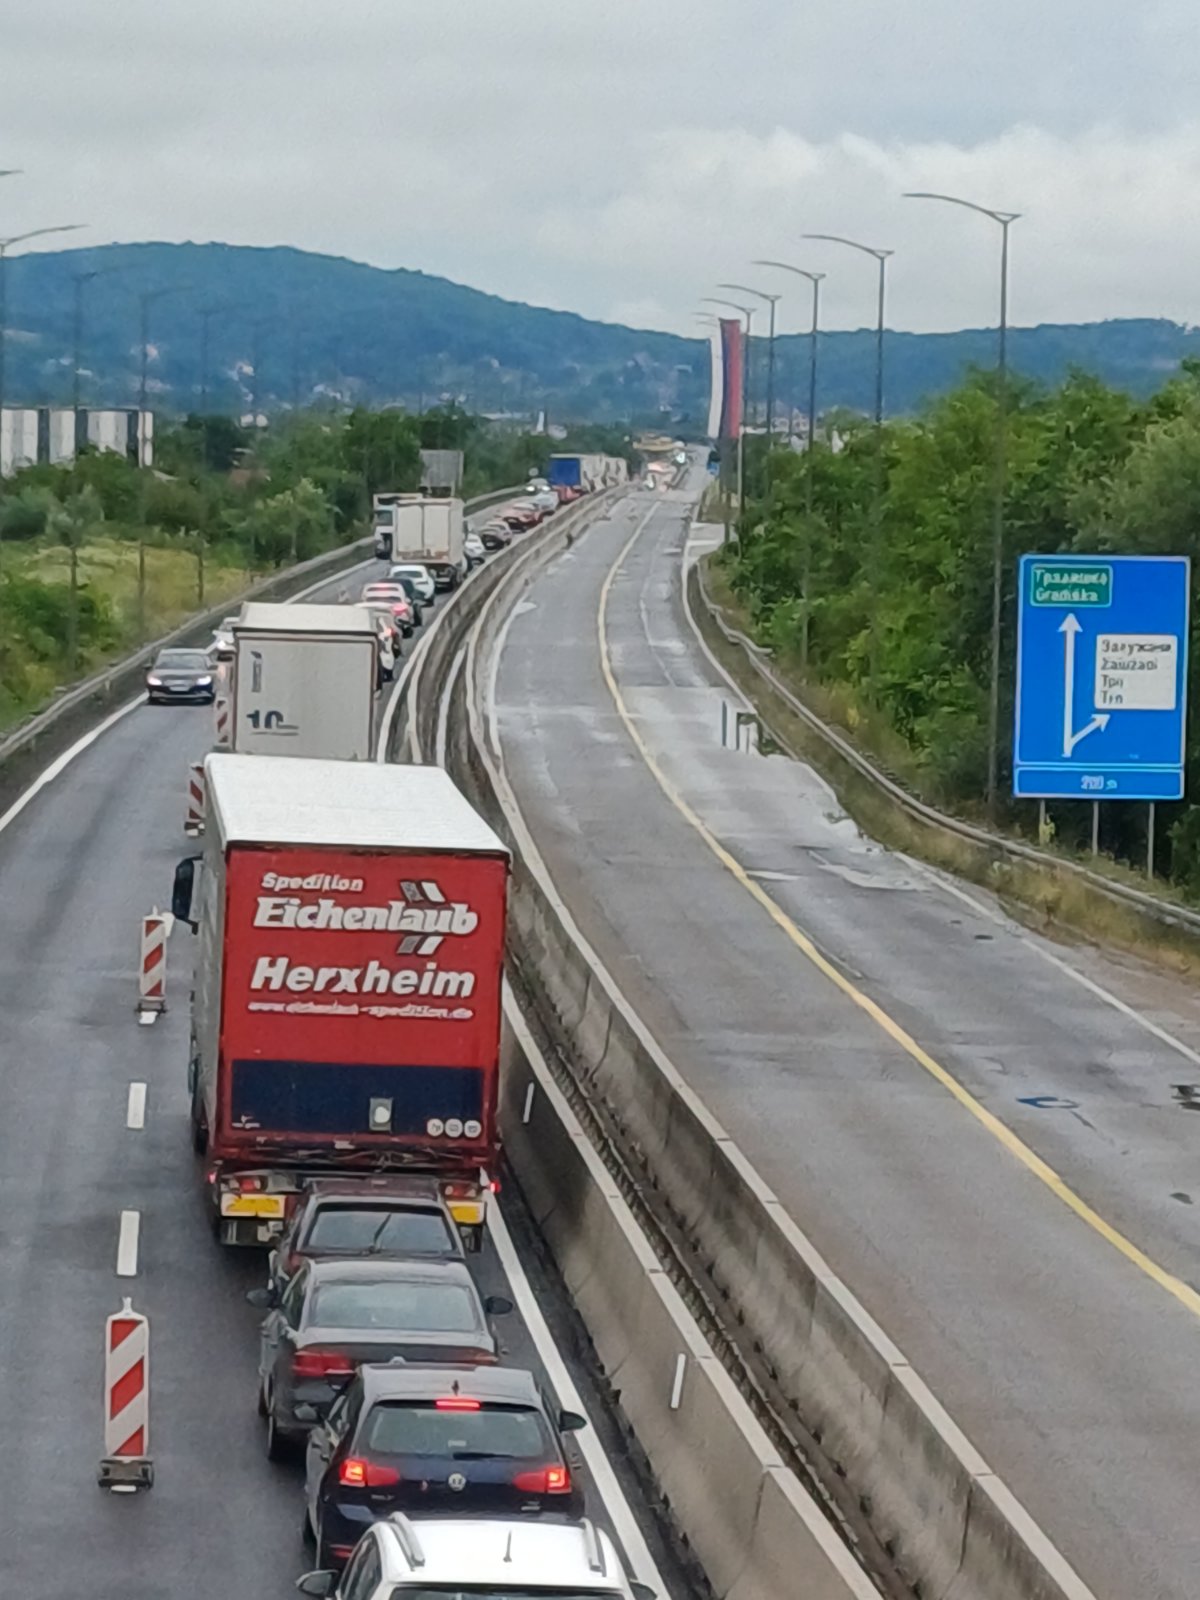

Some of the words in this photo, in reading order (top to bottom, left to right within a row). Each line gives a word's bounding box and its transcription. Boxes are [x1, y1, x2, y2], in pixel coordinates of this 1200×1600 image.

[261, 872, 364, 892] Spedition
[253, 897, 478, 935] Eichenlaub
[250, 957, 475, 998] Herxheim
